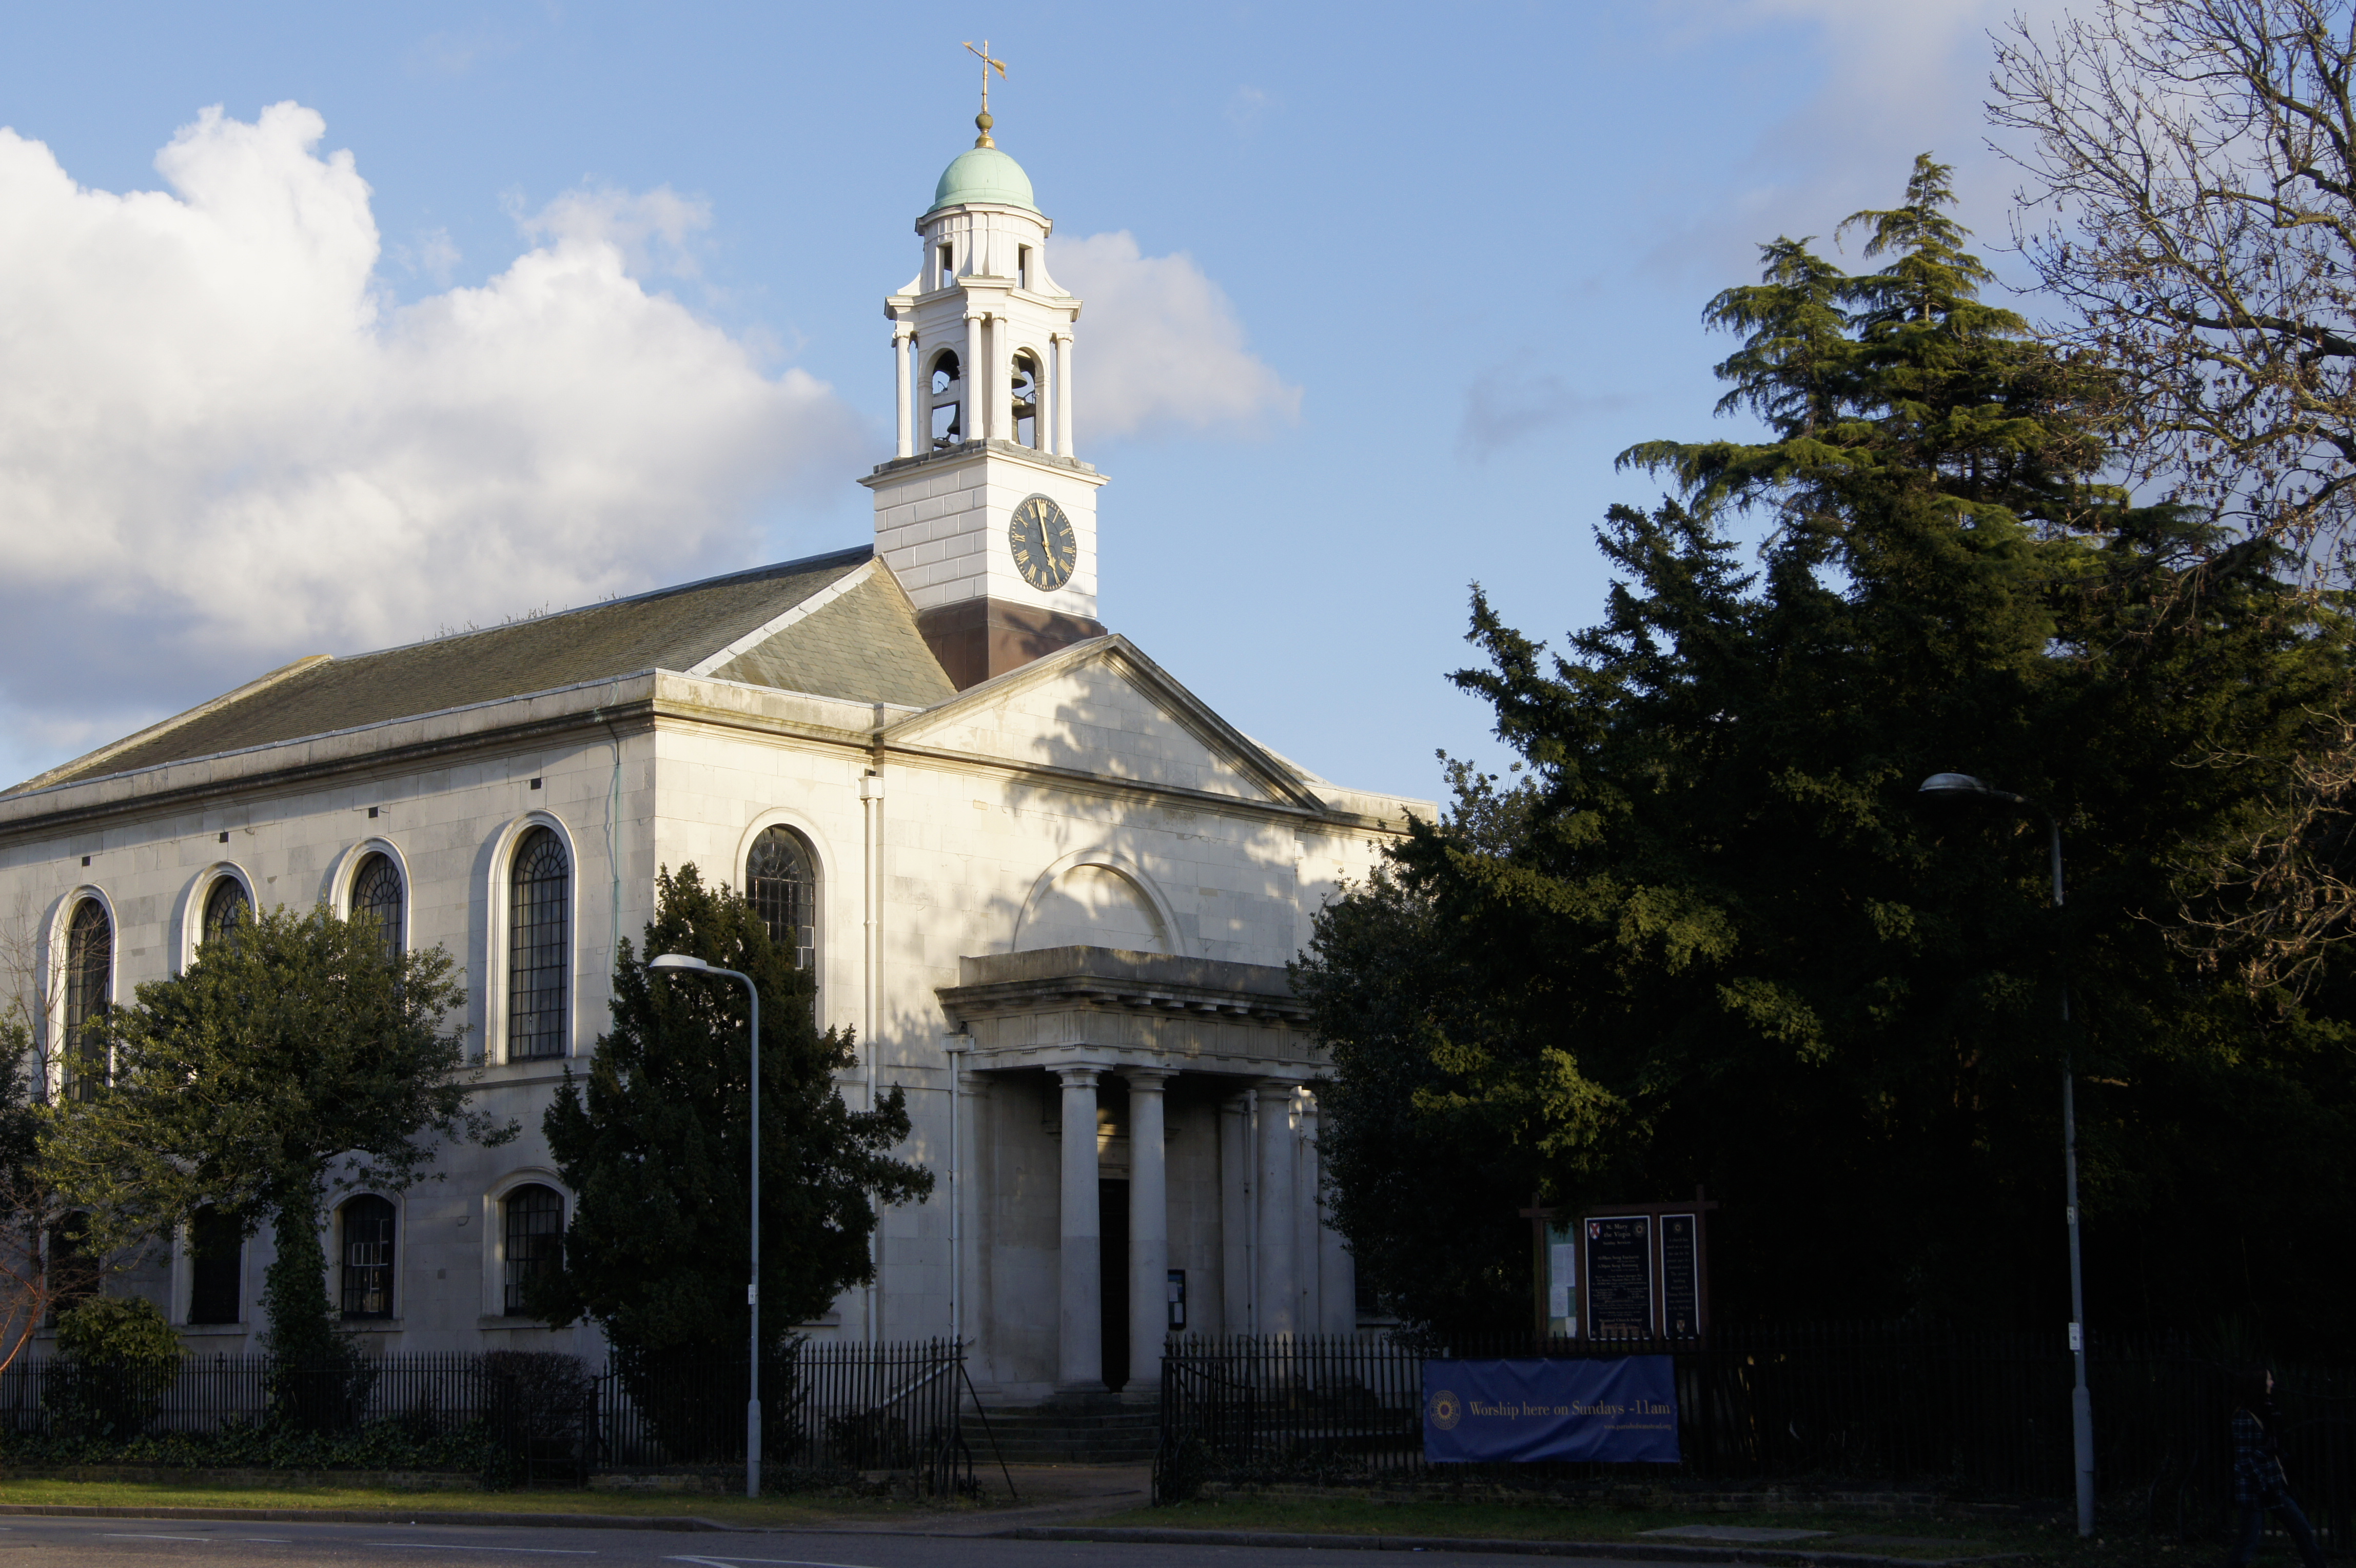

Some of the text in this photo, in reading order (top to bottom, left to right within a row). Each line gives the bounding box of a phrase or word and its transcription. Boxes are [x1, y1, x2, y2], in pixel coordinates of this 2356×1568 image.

[1614, 1223, 1628, 1232] Mary
[1469, 1401, 1519, 1420] Worship
[1523, 1401, 1550, 1416] here
[1554, 1406, 1568, 1416] on
[1572, 1400, 1625, 1418] Sundays
[1604, 1422, 1673, 1431] www.parishofwanstead.org
